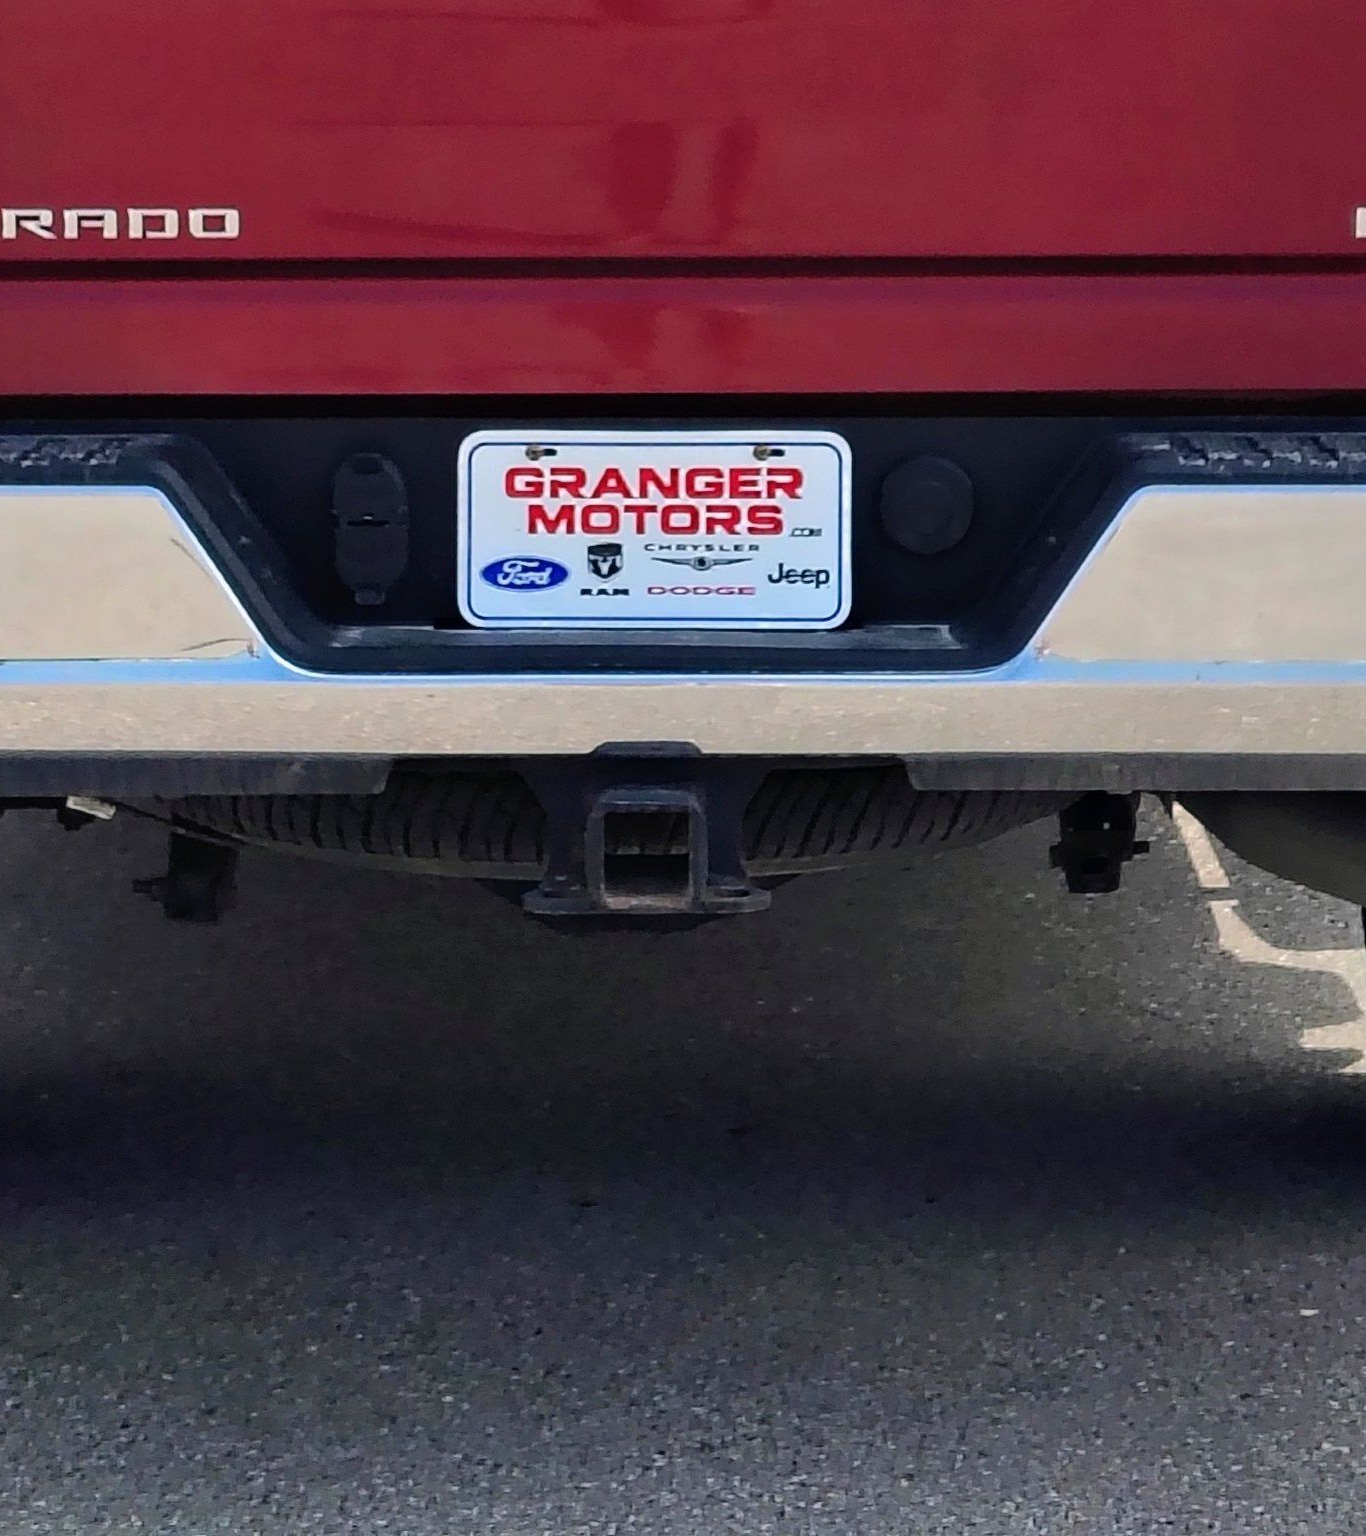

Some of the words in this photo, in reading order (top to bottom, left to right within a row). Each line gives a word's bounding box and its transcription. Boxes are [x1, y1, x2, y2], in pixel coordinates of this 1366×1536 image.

[505, 467, 803, 500] GRANGER
[527, 504, 784, 536] MOTORS
[644, 544, 760, 552] CHRYSLER
[497, 561, 553, 586] Ford
[767, 562, 830, 589] Jeep
[580, 588, 630, 596] RAM
[647, 586, 756, 596] DODGE
